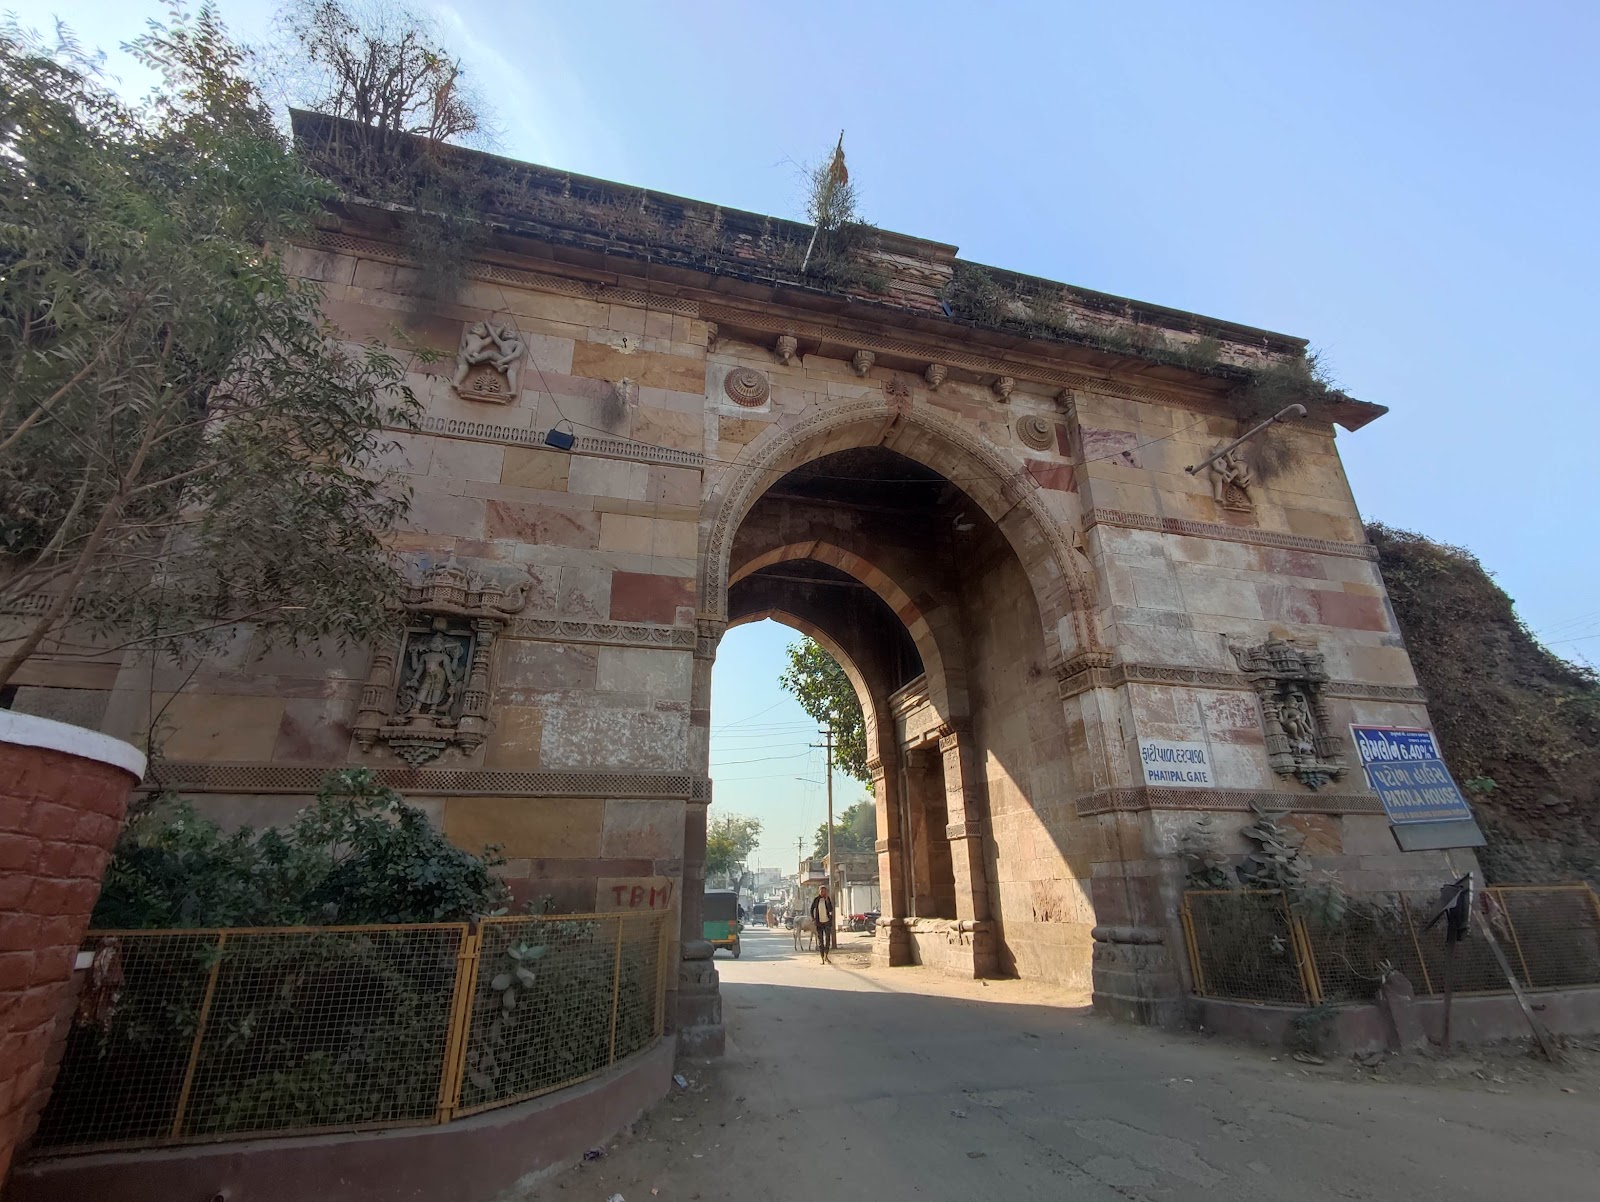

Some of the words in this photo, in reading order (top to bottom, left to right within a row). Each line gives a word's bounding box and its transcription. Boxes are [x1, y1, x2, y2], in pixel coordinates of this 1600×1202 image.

[1359, 730, 1400, 762] હોમલોન
[1148, 770, 1186, 782] PHATIPAL
[1187, 771, 1208, 782] GATE
[1375, 765, 1413, 786] પટોળા
[1413, 763, 1447, 784] હાઉસ
[1384, 789, 1424, 807] PATOLA
[1423, 787, 1460, 805] HOUSE
[611, 885, 668, 910] TBM
